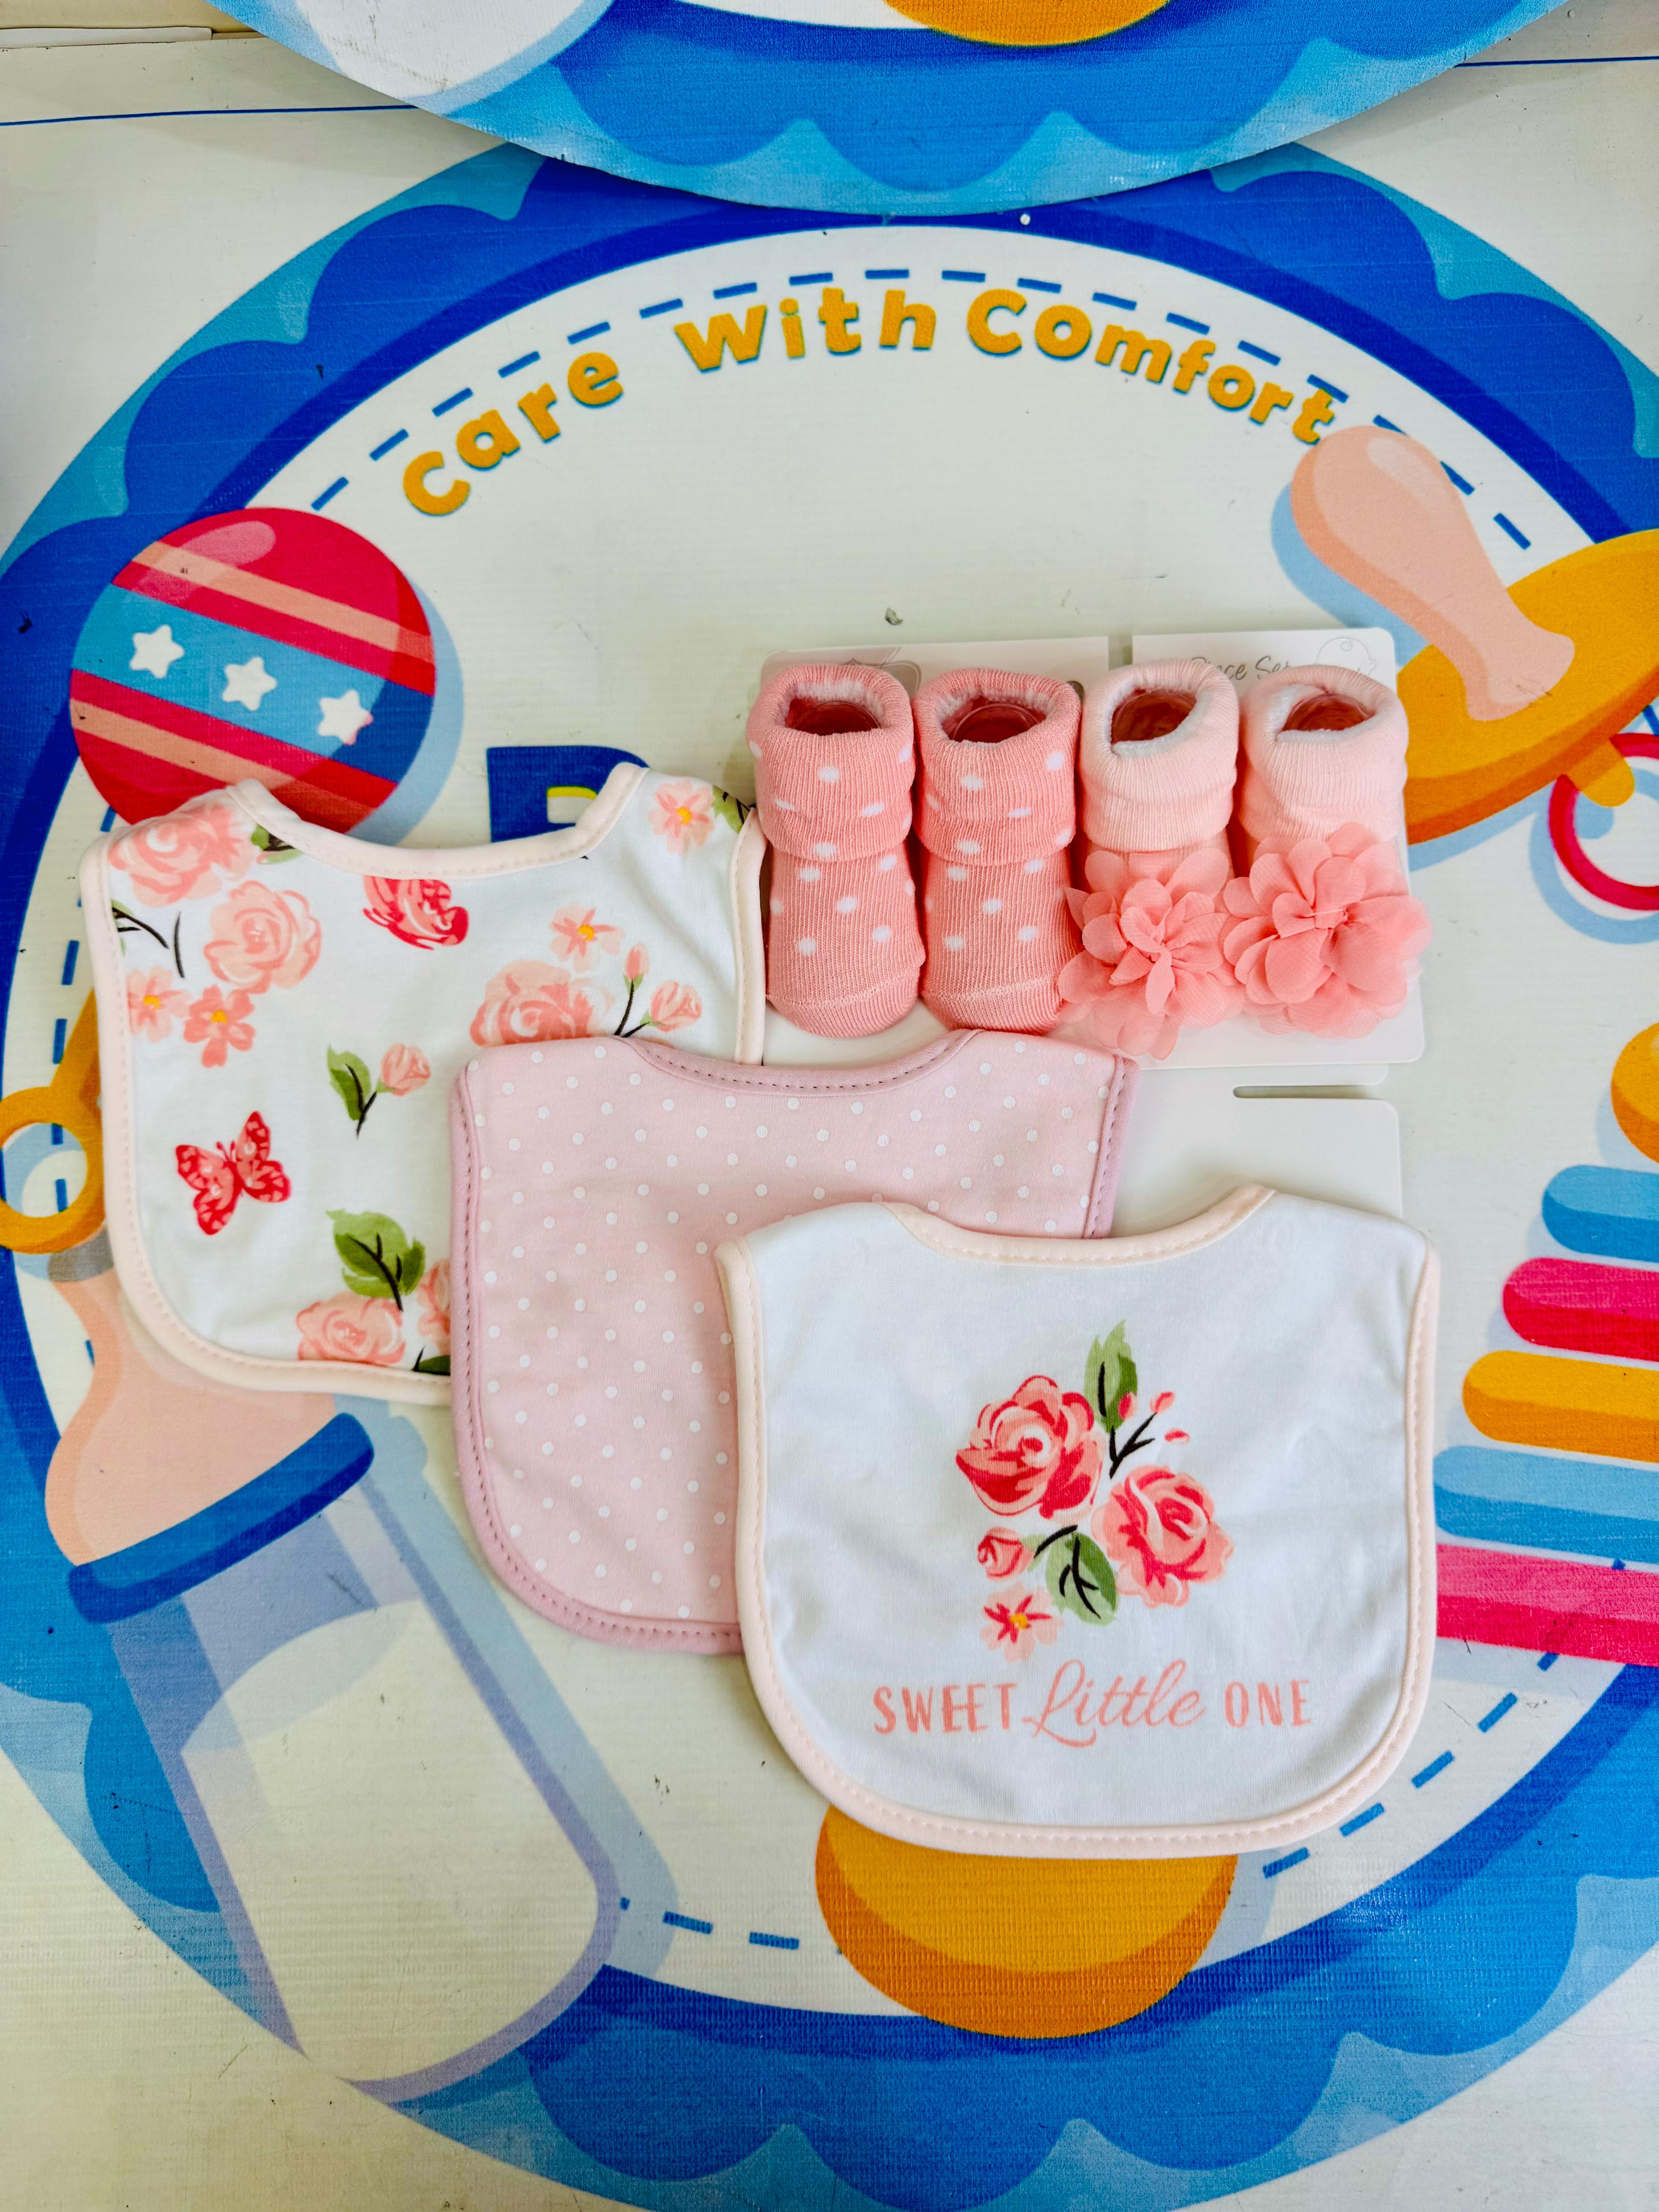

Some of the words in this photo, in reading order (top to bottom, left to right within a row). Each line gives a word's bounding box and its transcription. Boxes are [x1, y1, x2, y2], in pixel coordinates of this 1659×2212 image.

[967, 289, 1335, 445] Comfort
[873, 1682, 1017, 1734] SWEET
[1021, 1660, 1206, 1748] Little
[1225, 1679, 1312, 1729] ONE
